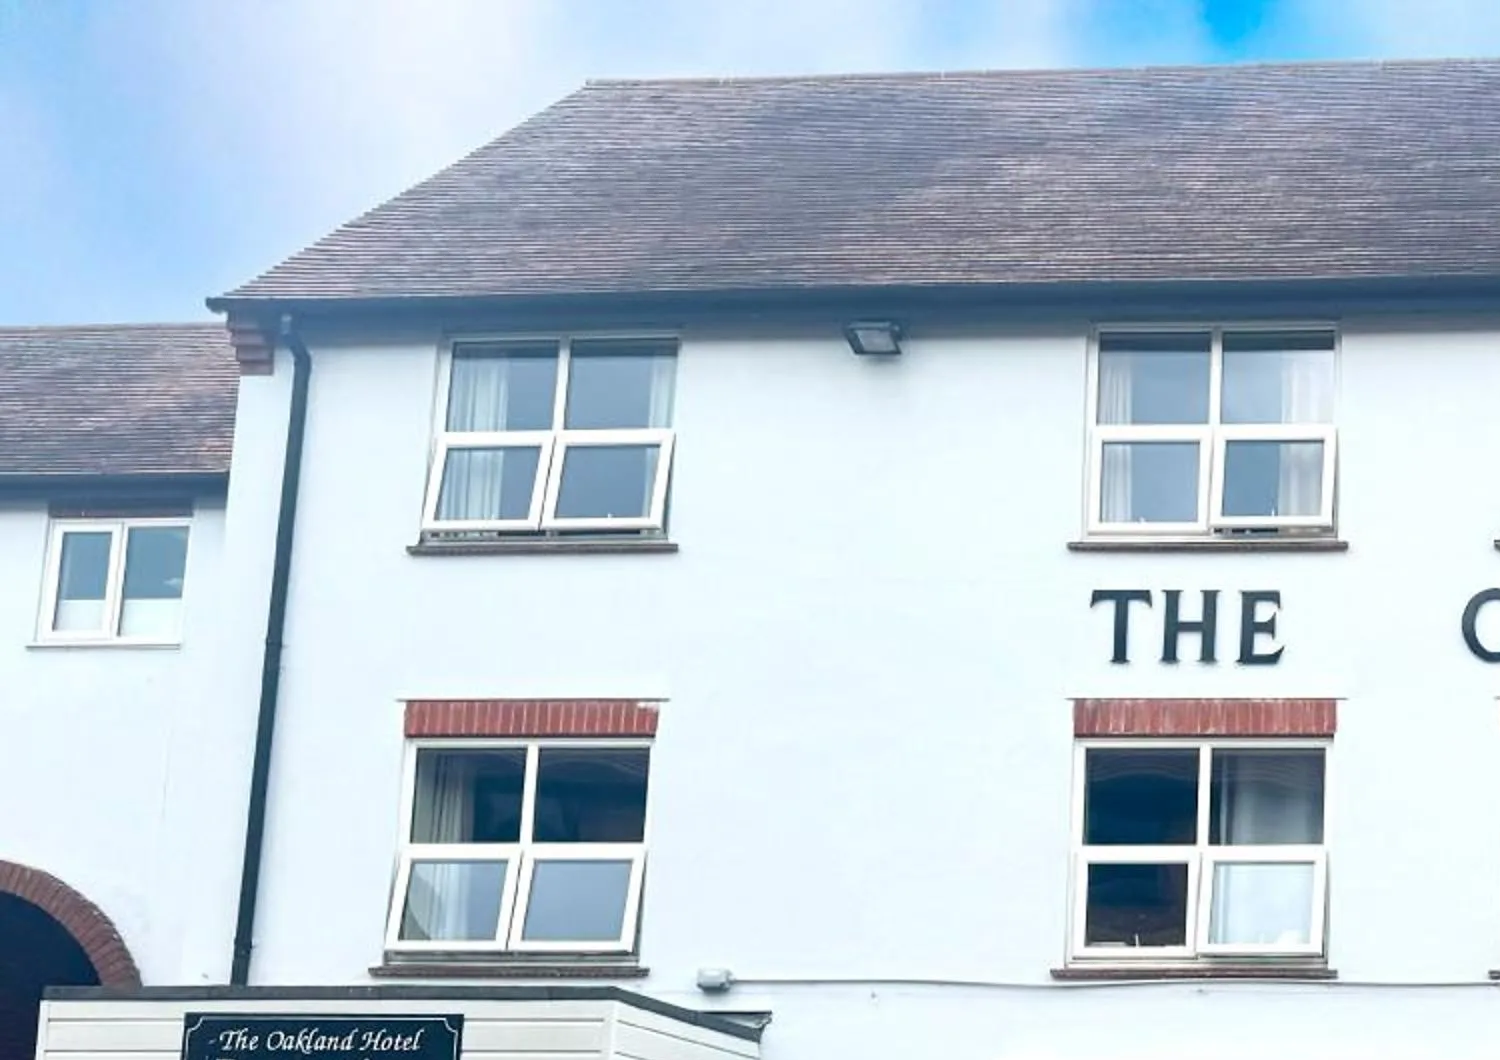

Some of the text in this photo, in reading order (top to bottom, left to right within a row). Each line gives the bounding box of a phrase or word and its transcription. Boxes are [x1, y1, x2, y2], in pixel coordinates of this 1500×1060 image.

[1089, 588, 1285, 666] THE
[218, 1027, 425, 1055] The Oakland Hotel
